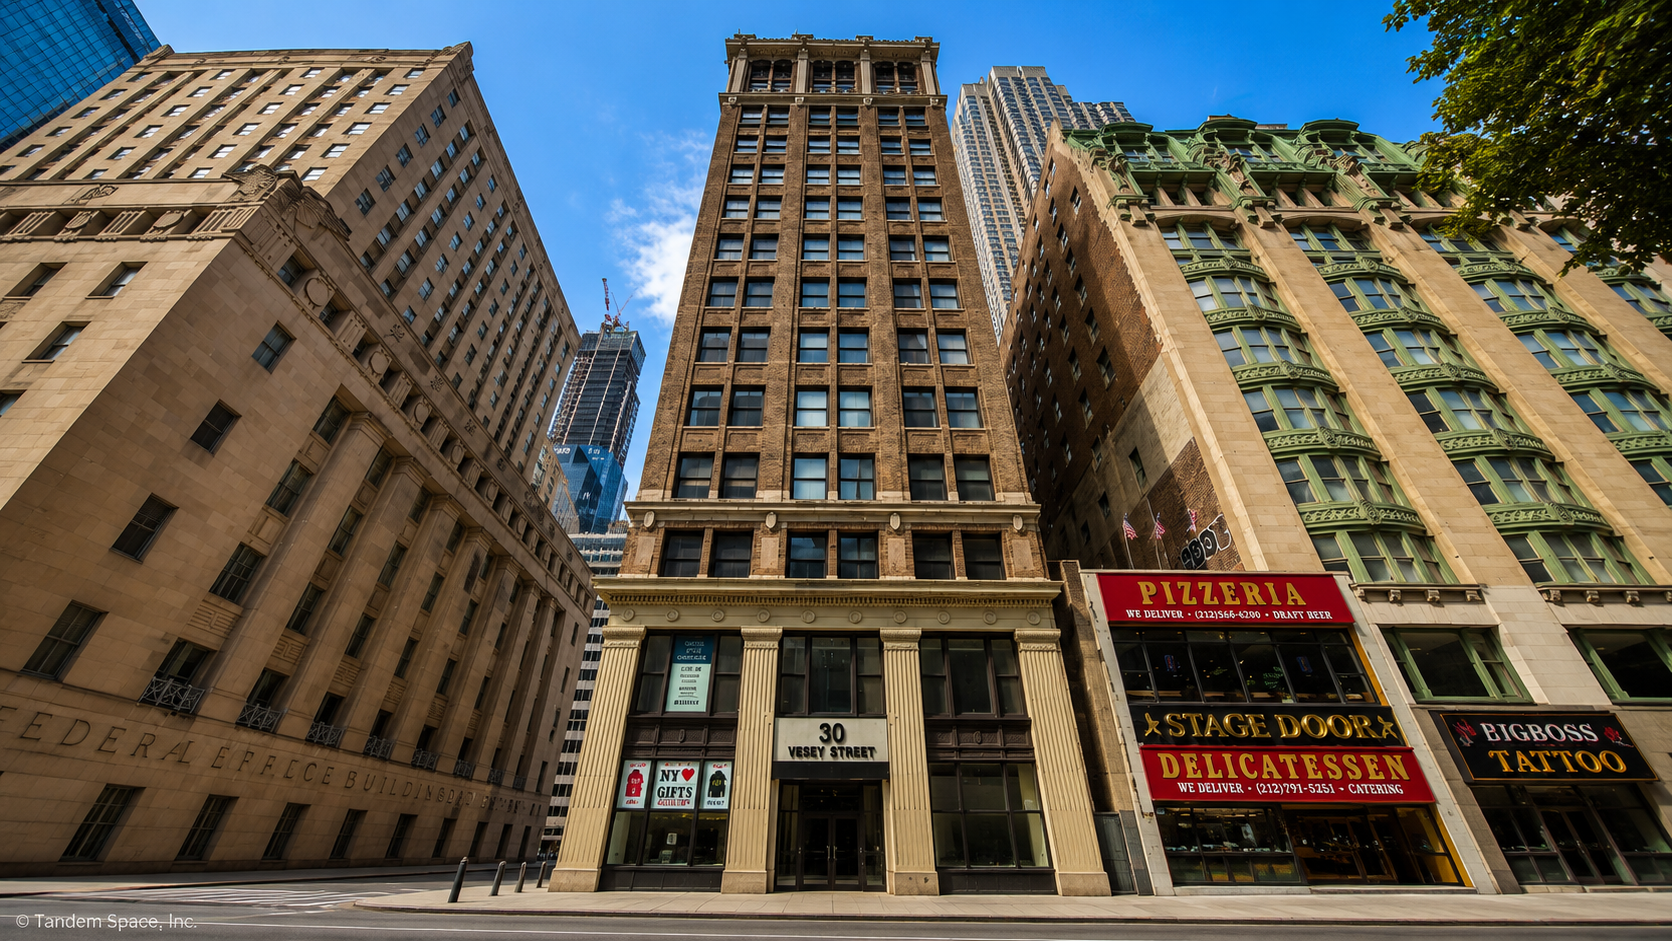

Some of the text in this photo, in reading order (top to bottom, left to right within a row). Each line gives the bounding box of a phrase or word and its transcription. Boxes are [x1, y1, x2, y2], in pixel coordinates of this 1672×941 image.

[1137, 581, 1307, 606] PIZZERIA
[1125, 609, 1142, 618] WE
[1143, 609, 1184, 619] DELIVER
[1272, 610, 1304, 619] DRAFT
[818, 722, 845, 743] 30
[1163, 713, 1384, 739] STAGE DOOR
[1480, 722, 1599, 742] BIGBOSS
[788, 746, 877, 760] VESEY STREET
[1488, 750, 1627, 773] TATTOO
[659, 769, 681, 782] NY
[1157, 752, 1412, 781] DELICATESSEN
[657, 786, 693, 798] GIFTS
[1177, 782, 1195, 793] WE
[1197, 782, 1245, 794] DELIVER
[1348, 783, 1404, 794] CATERING
